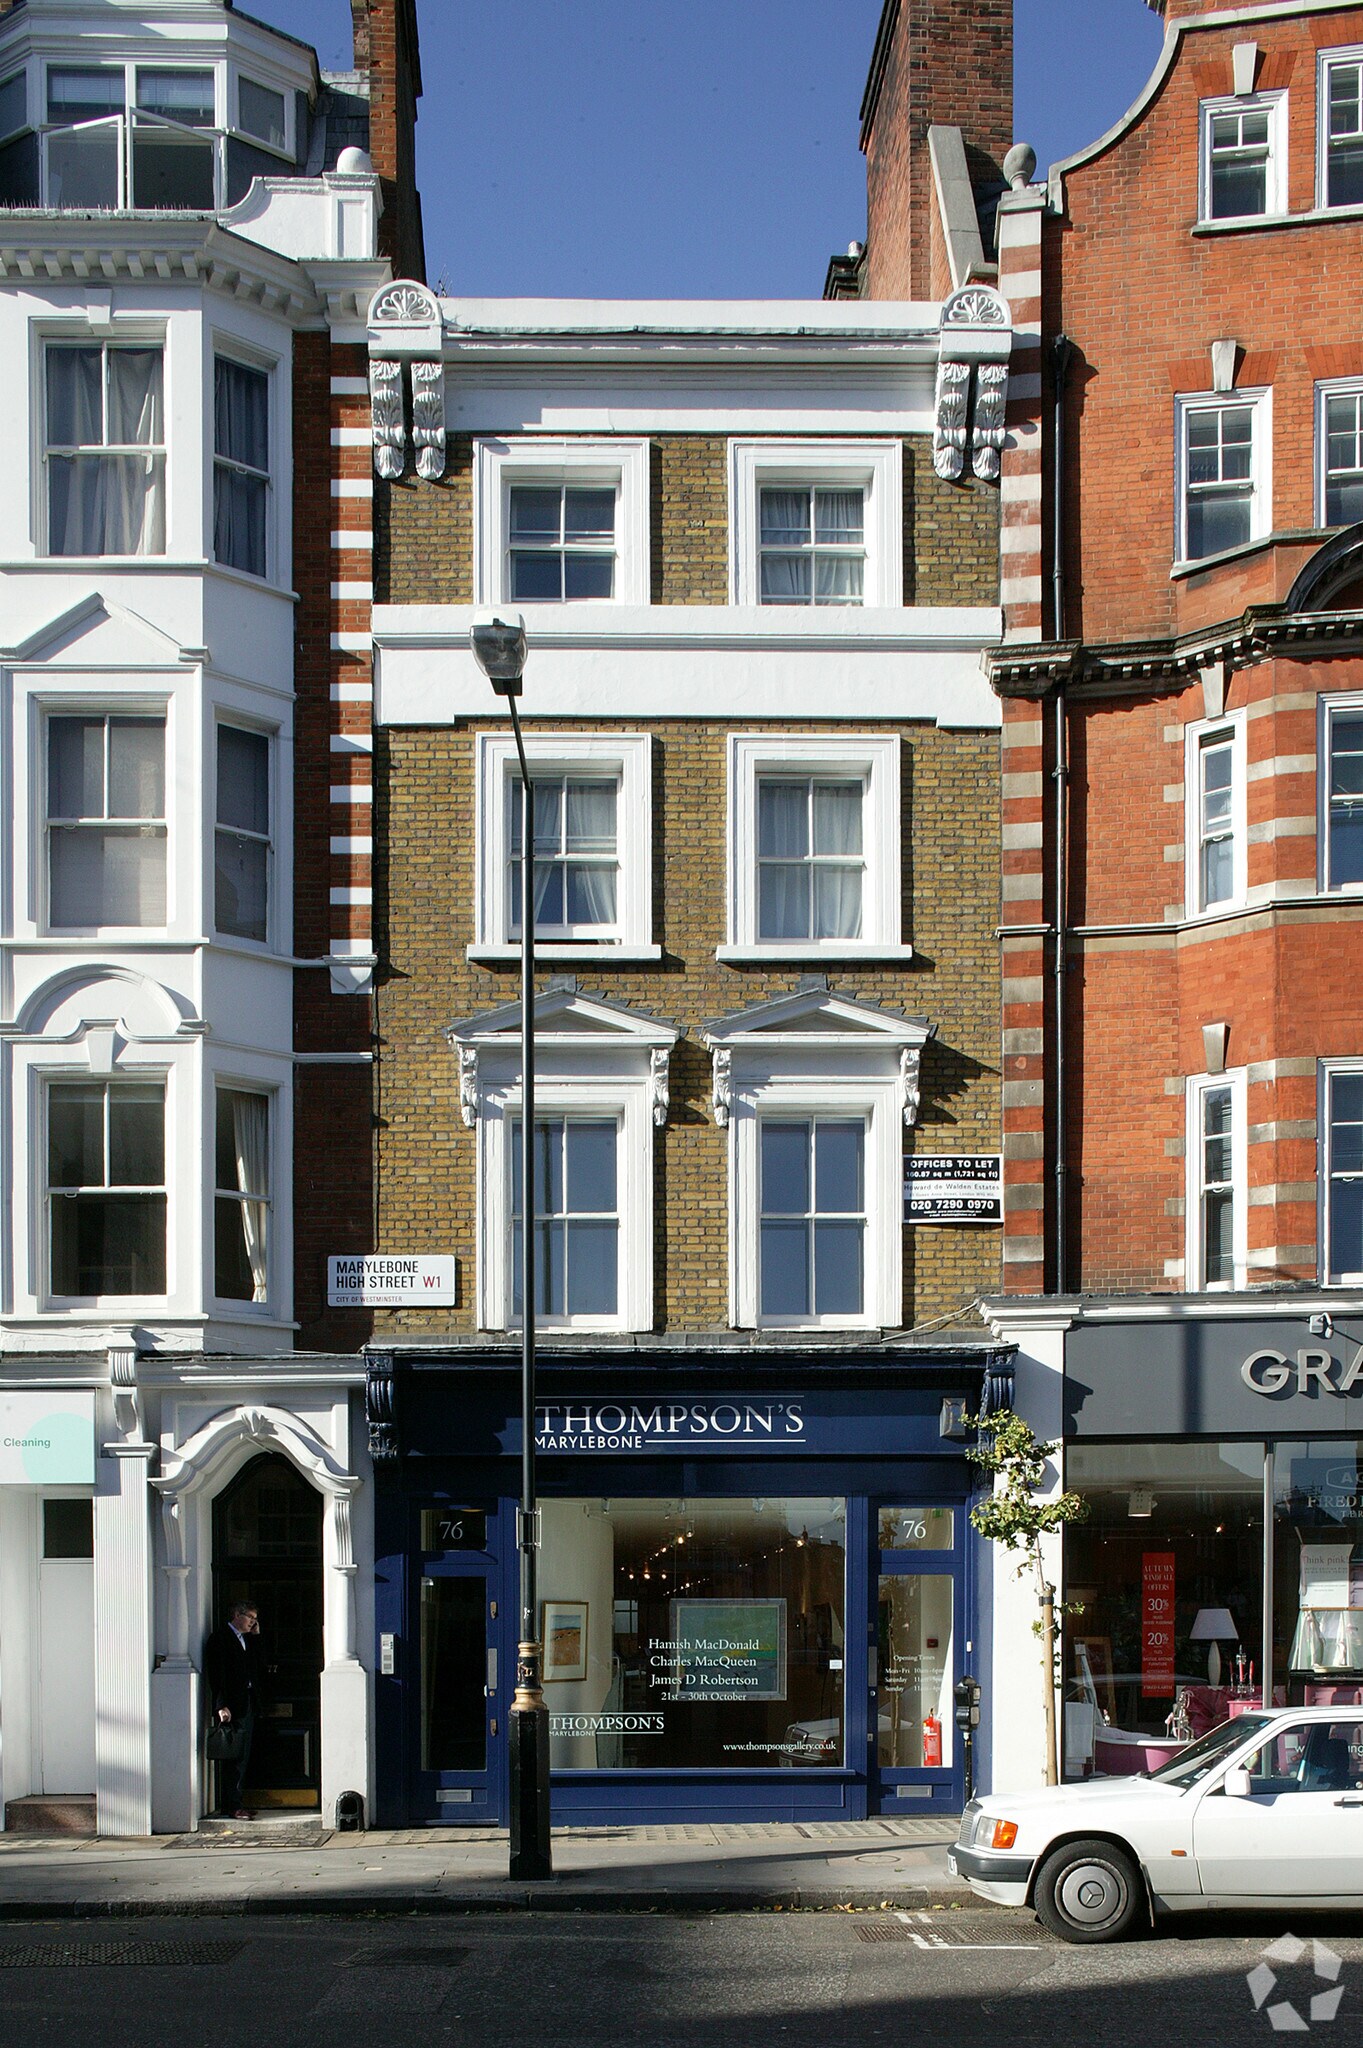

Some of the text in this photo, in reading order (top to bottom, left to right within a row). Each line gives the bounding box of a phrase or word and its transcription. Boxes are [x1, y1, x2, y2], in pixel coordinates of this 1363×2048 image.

[910, 1160, 994, 1168] OFFICES TO LET
[910, 1200, 994, 1210] 020 7290 0970
[336, 1261, 418, 1273] MARYLEBONE
[336, 1276, 441, 1288] HIGH STREET W1
[535, 1404, 804, 1433] THOMPSON'S
[3, 1437, 51, 1449] Cleaning
[535, 1436, 642, 1448] MARYLEBONE
[439, 1520, 463, 1540] 76
[903, 1520, 926, 1539] 76
[1147, 1598, 1169, 1611] 30%
[648, 1639, 759, 1650] Hamish MacDonald
[1147, 1632, 1169, 1646] 20%
[650, 1655, 757, 1669] Charles MacQueen
[649, 1674, 758, 1688] James D Robertson
[661, 1692, 678, 1700] 21st
[688, 1692, 708, 1700] 30th
[710, 1692, 747, 1700] October
[550, 1716, 664, 1730] THOMPSON'S
[723, 1741, 836, 1752] www.thompsonsgallery.co.uk
